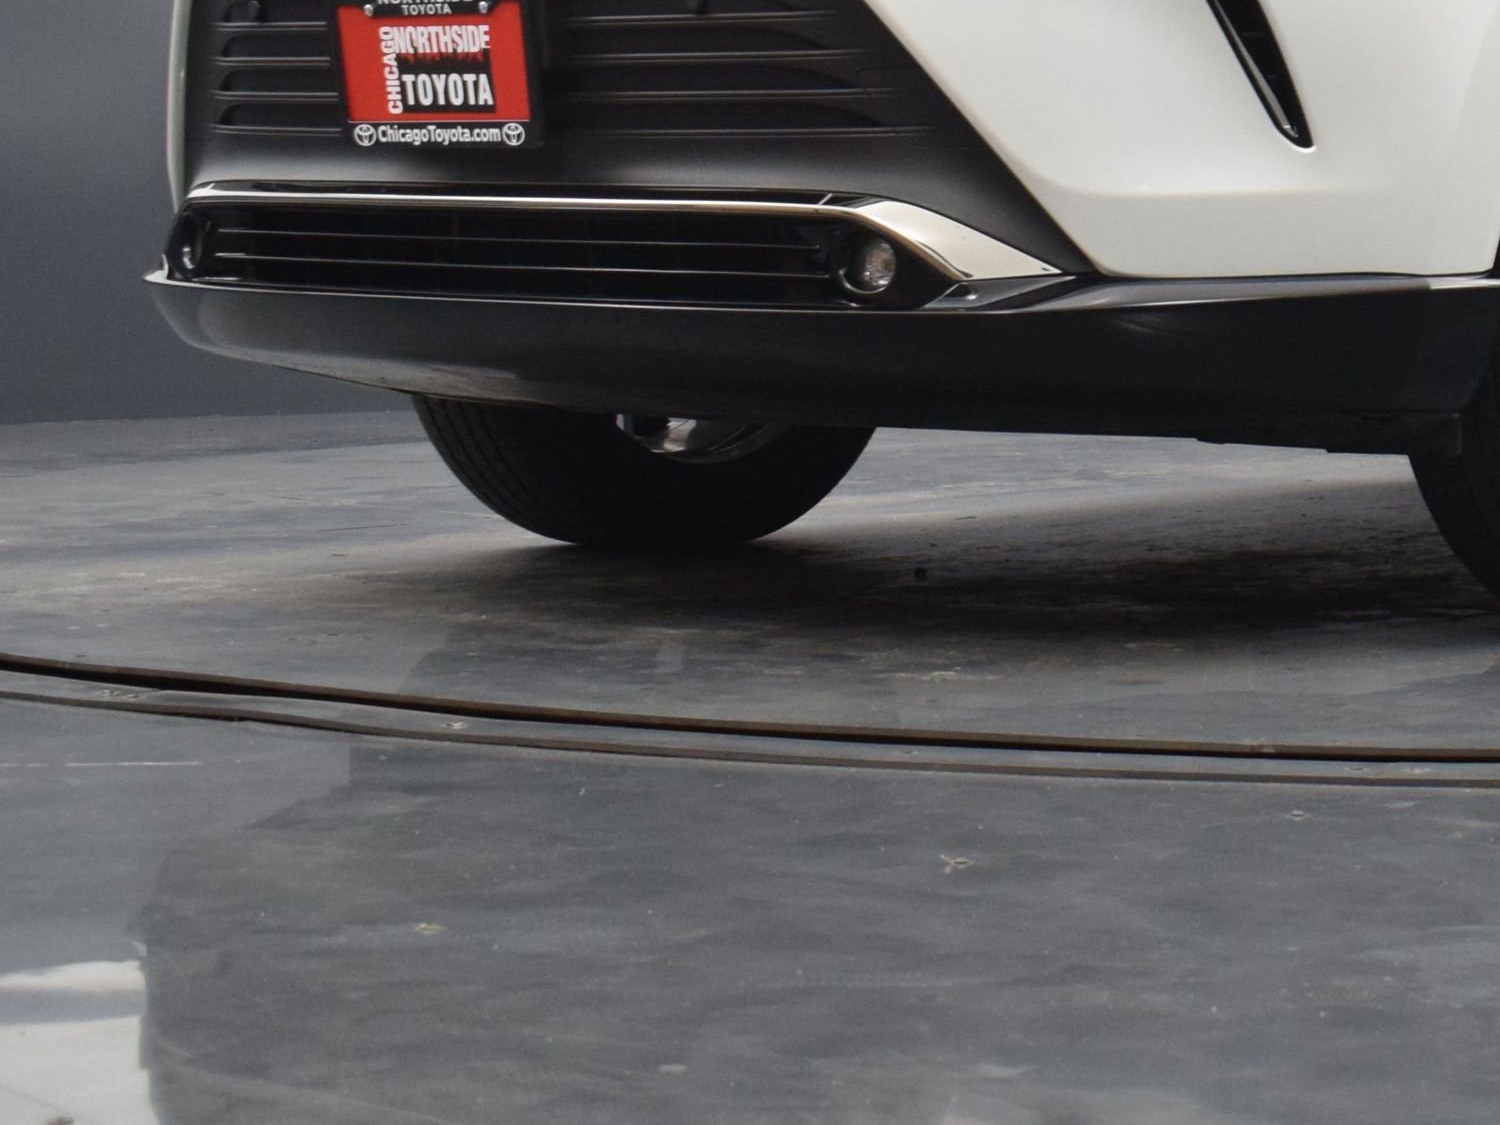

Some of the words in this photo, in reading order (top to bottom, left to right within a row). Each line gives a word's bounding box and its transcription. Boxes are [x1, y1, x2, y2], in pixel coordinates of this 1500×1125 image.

[403, 4, 451, 15] TOYOTA
[394, 25, 491, 54] NORTHSIDE
[379, 26, 403, 114] CHICAGO
[402, 73, 494, 106] TOYOTA
[378, 126, 501, 145] ChicagoToyota.com
